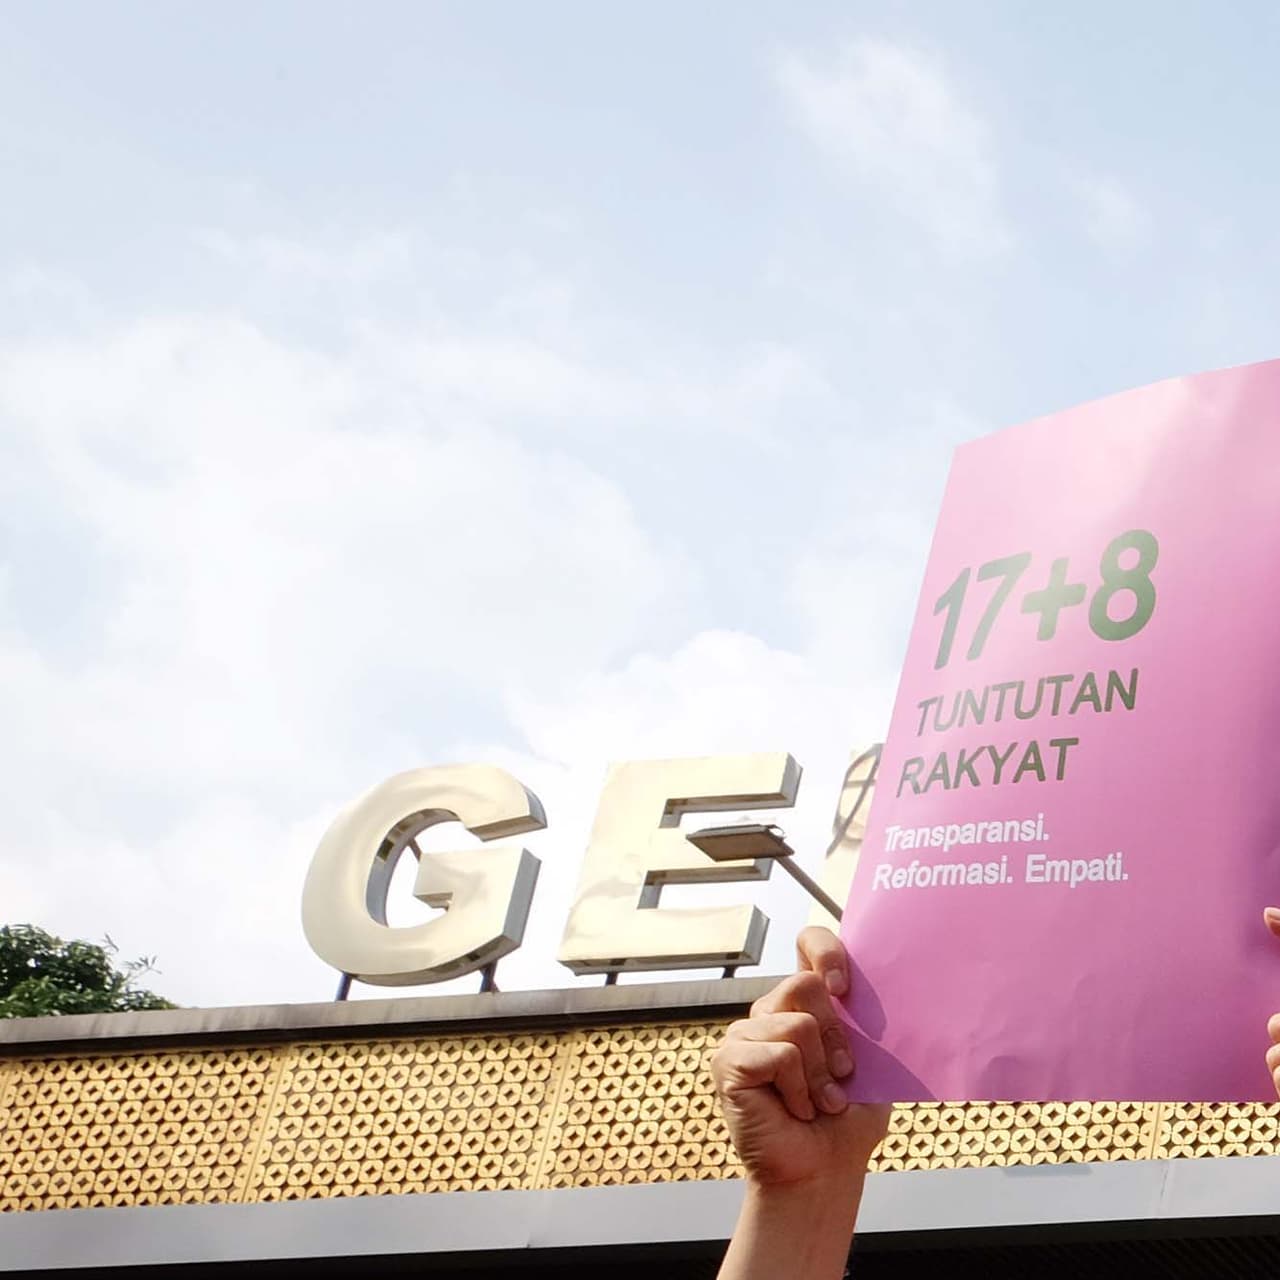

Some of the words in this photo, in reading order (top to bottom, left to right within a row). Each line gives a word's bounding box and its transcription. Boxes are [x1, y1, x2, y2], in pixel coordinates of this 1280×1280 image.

[933, 529, 1160, 670] 17+8
[916, 667, 1139, 737] TUNTUTAN
[896, 737, 1080, 798] RAKYAT
[885, 813, 1049, 852] Transparansi.
[872, 856, 1013, 891] Reformasi.
[1025, 852, 1129, 888] Empati.
